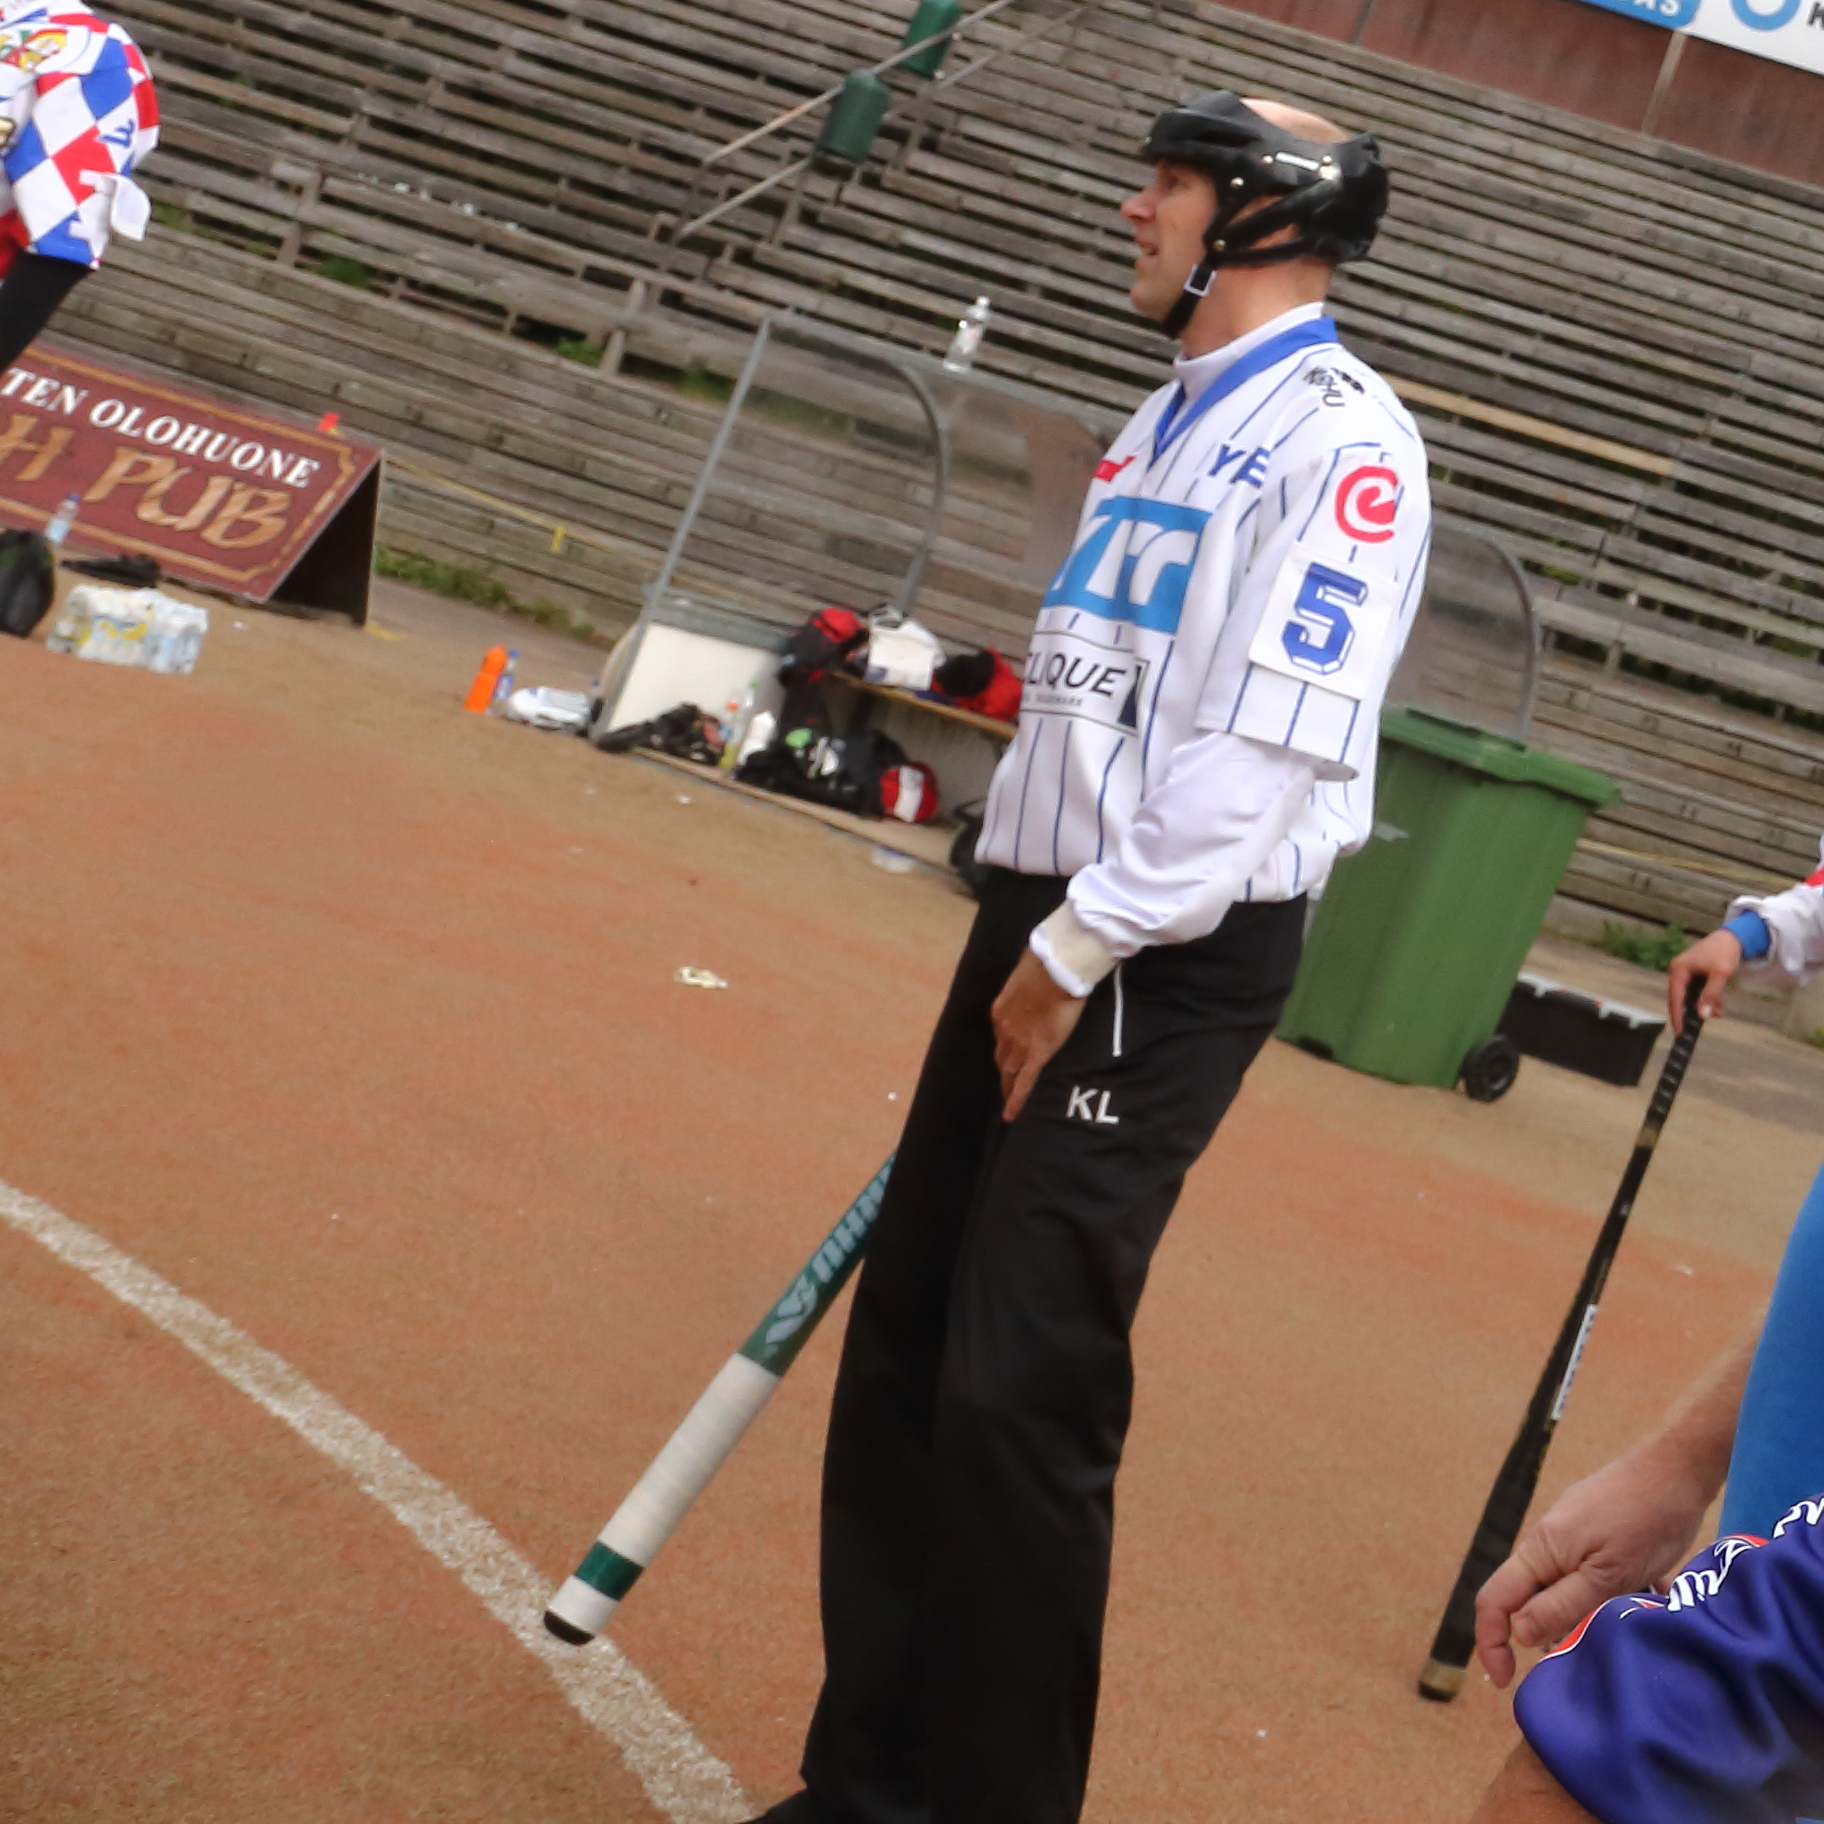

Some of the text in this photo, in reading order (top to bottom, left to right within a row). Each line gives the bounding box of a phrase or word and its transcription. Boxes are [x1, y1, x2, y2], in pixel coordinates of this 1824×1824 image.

[88, 397, 322, 489] OLOHUONE
[82, 445, 293, 550] PUB
[1281, 562, 1368, 675] 5
[1026, 649, 1129, 698] LIQUE
[1066, 1085, 1120, 1124] KL
